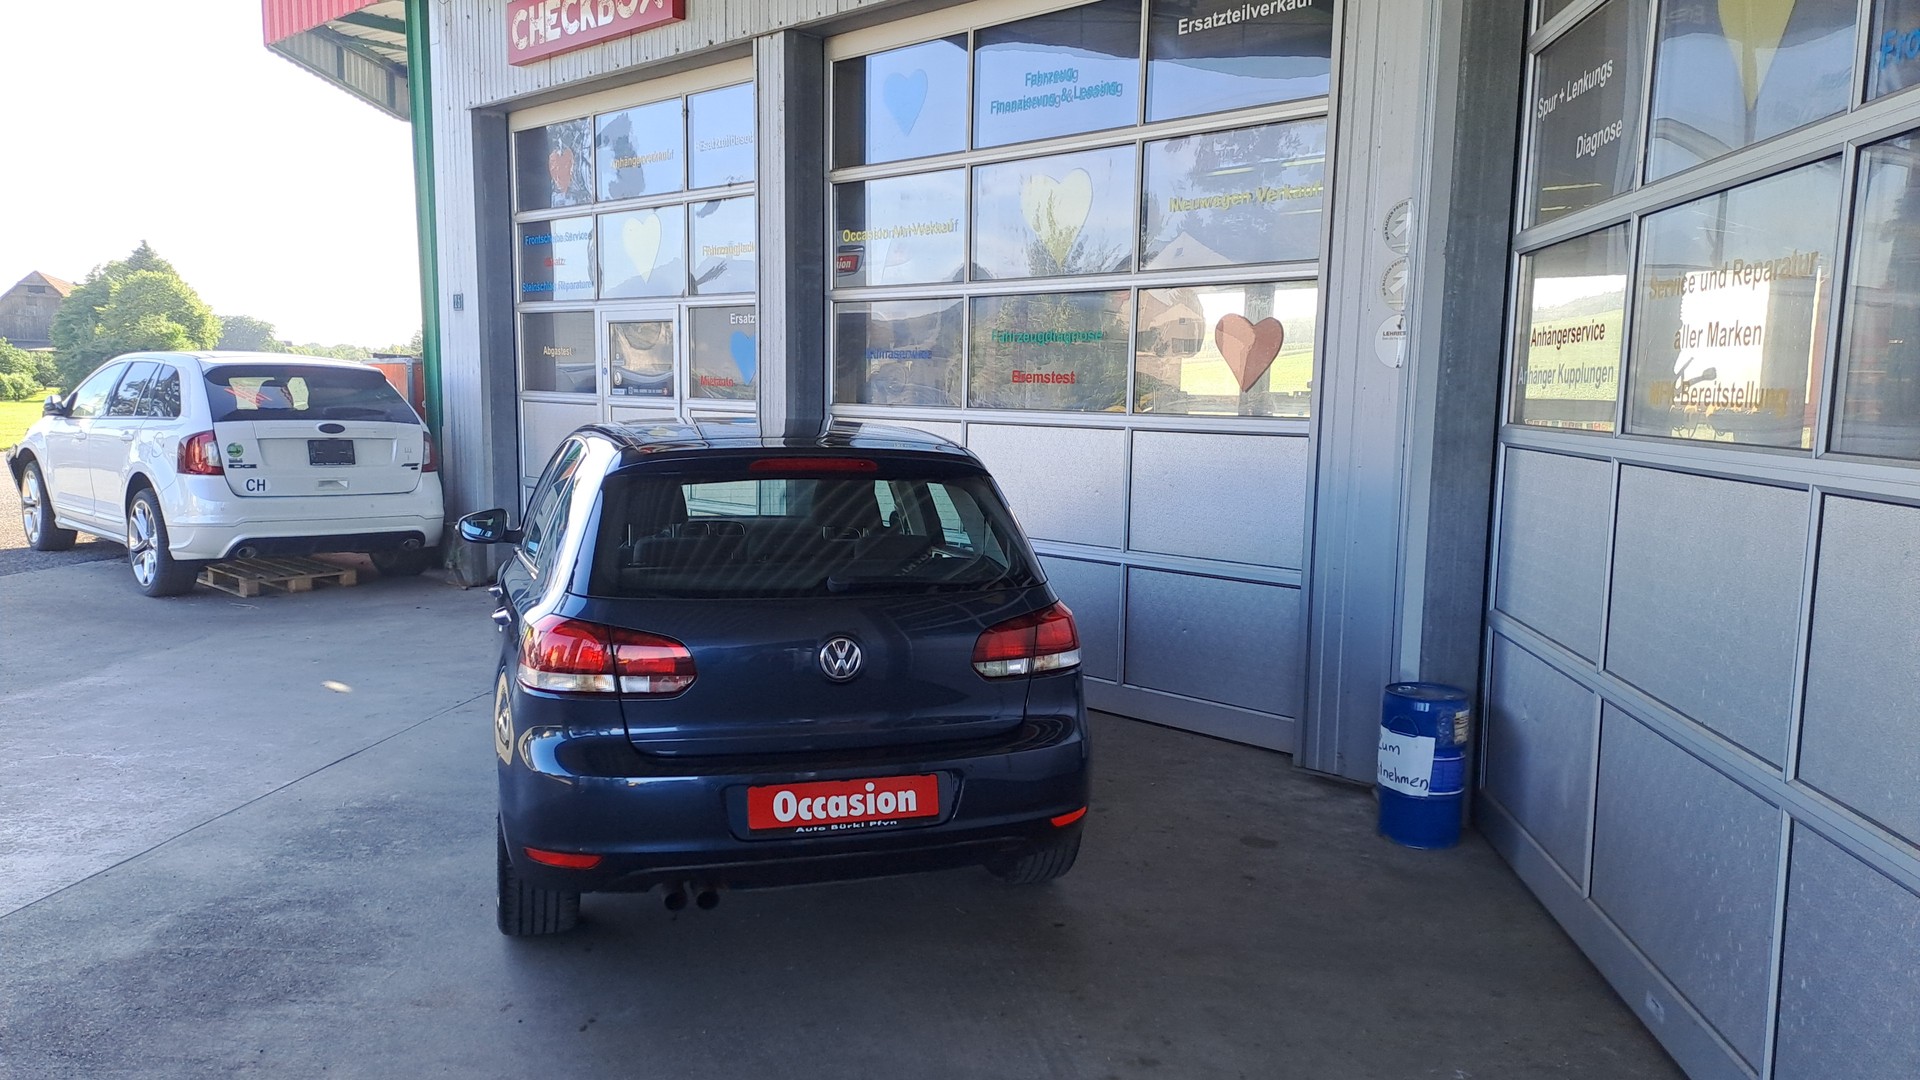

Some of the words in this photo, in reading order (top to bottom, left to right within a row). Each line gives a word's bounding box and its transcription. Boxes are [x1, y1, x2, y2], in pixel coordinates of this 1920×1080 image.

[1025, 67, 1079, 88] Fahrzeug
[1537, 95, 1559, 119] Spur
[1566, 58, 1614, 102] Lenkungs
[1575, 118, 1623, 159] Diagnose
[1168, 191, 1254, 213] Neuwagen
[1256, 180, 1323, 202] Verkauf
[1649, 274, 1696, 300] Service
[1700, 267, 1728, 291] und
[1732, 250, 1820, 288] Reparatur
[991, 329, 1104, 346] Fahrzeugdiagnose
[1531, 321, 1606, 350] Anhängerservice
[1673, 326, 1704, 350] aller
[1706, 321, 1762, 348] Marken
[543, 345, 573, 357] Abgastest
[1011, 370, 1076, 385] Bremstest
[1518, 367, 1556, 387] Anhänger
[1557, 364, 1614, 390] Kupplungen
[246, 478, 266, 492] CH
[773, 782, 917, 822] Occasion
[795, 825, 826, 833] Auto
